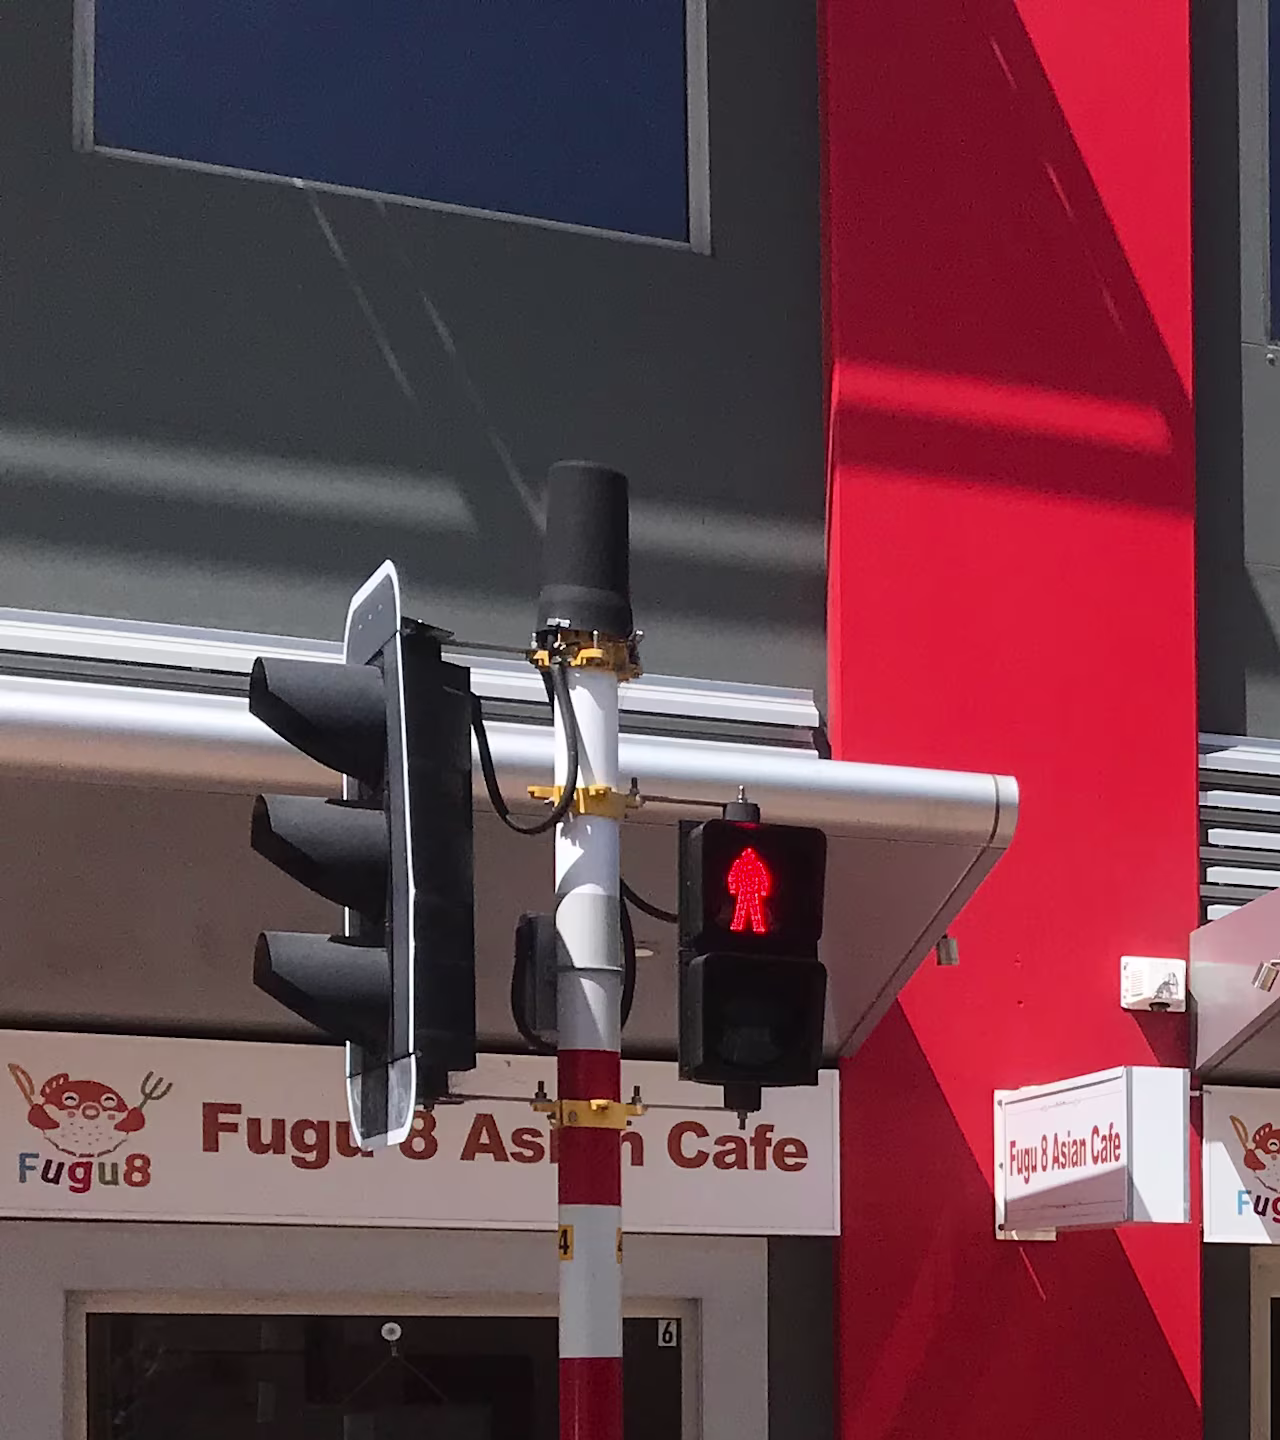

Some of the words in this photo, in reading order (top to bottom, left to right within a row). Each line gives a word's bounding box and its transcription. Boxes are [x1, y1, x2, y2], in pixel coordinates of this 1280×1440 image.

[399, 1110, 438, 1161] 8
[666, 1120, 809, 1172] Cafe
[1009, 1140, 1038, 1184] Fugu
[1040, 1134, 1048, 1172] 8
[1051, 1130, 1087, 1171] Asian
[1090, 1122, 1122, 1165] Cafe
[17, 1152, 152, 1194] Fugu8
[558, 1228, 570, 1256] 4
[661, 1320, 674, 1345] 6
